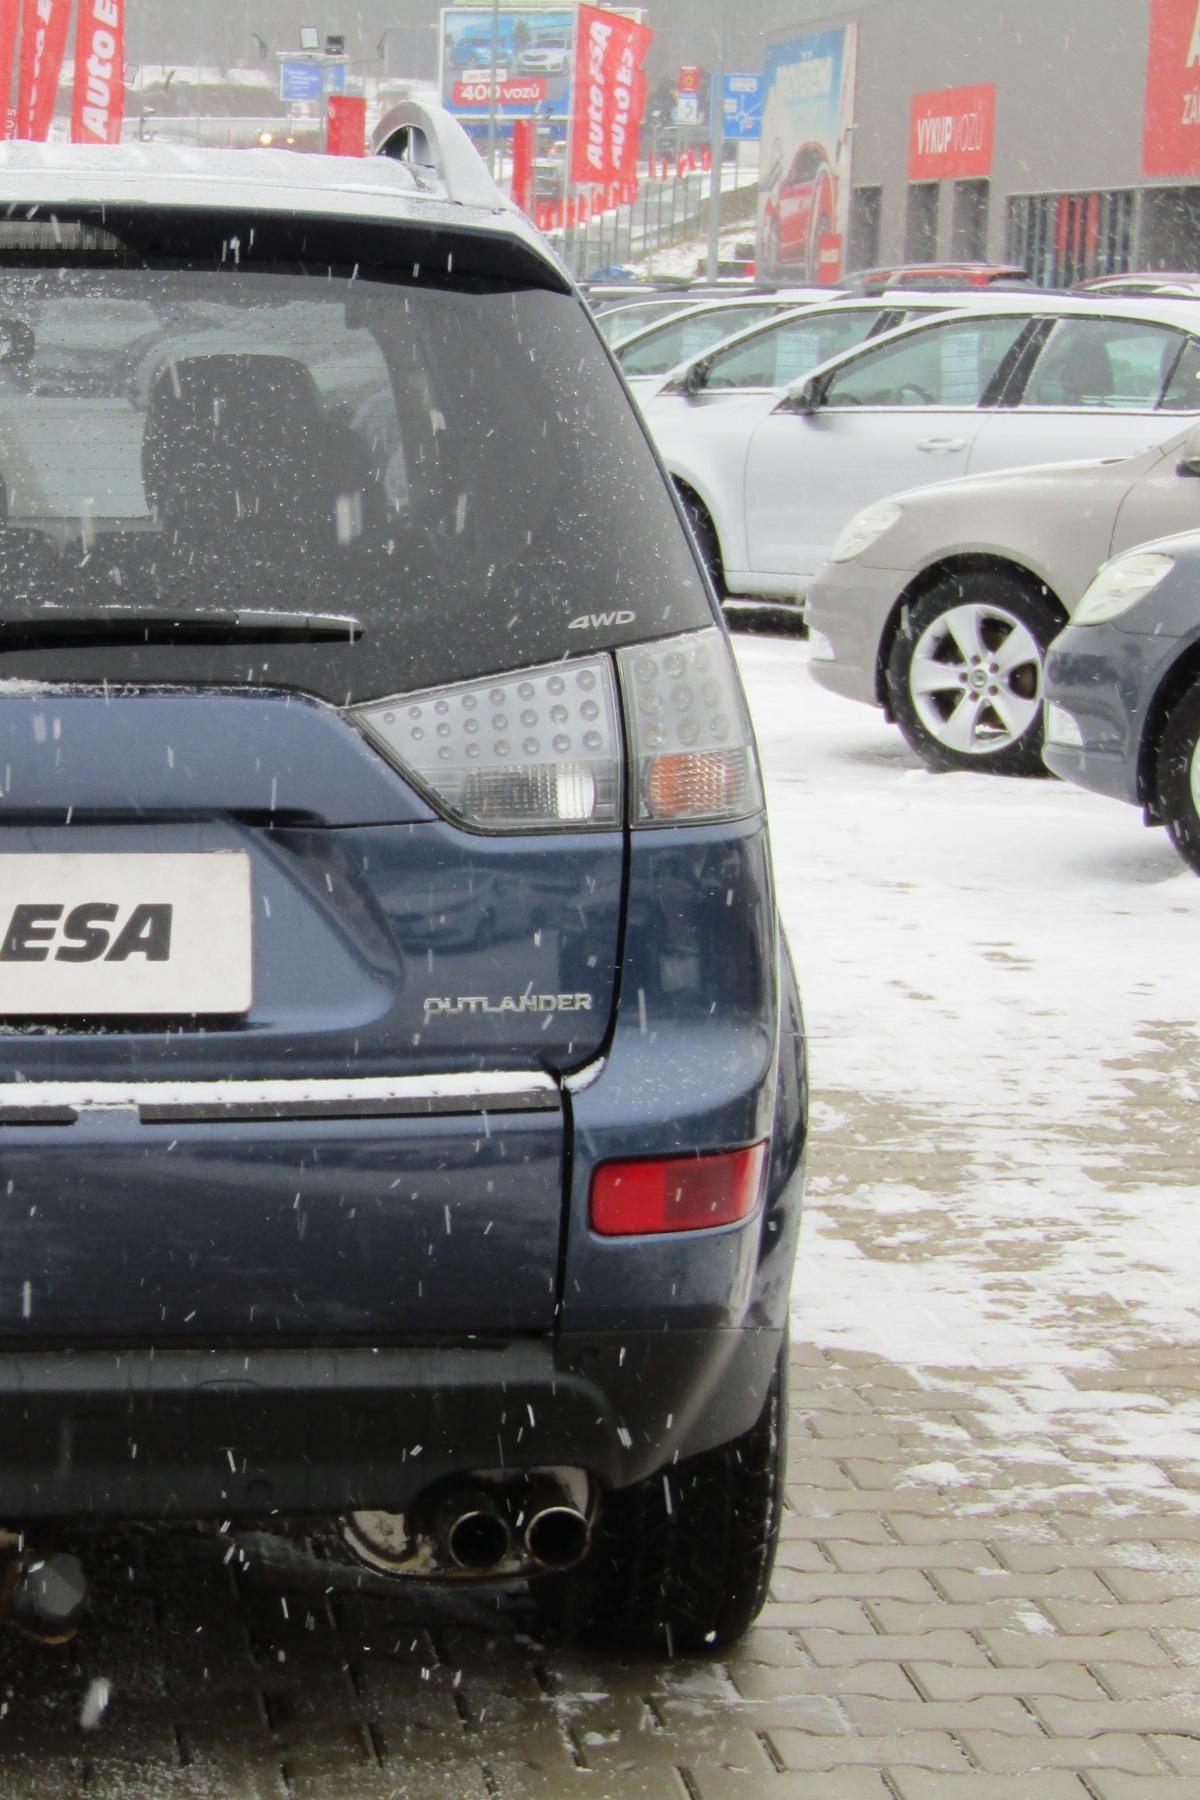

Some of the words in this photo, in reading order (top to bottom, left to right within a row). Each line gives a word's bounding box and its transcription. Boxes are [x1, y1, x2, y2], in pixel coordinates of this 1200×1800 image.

[82, 29, 116, 140] Auto
[461, 84, 500, 100] 400
[587, 84, 604, 170] Auto
[918, 108, 952, 156] VÝKUP
[567, 610, 636, 629] 4WD
[423, 993, 593, 1015] OUTLANDER
